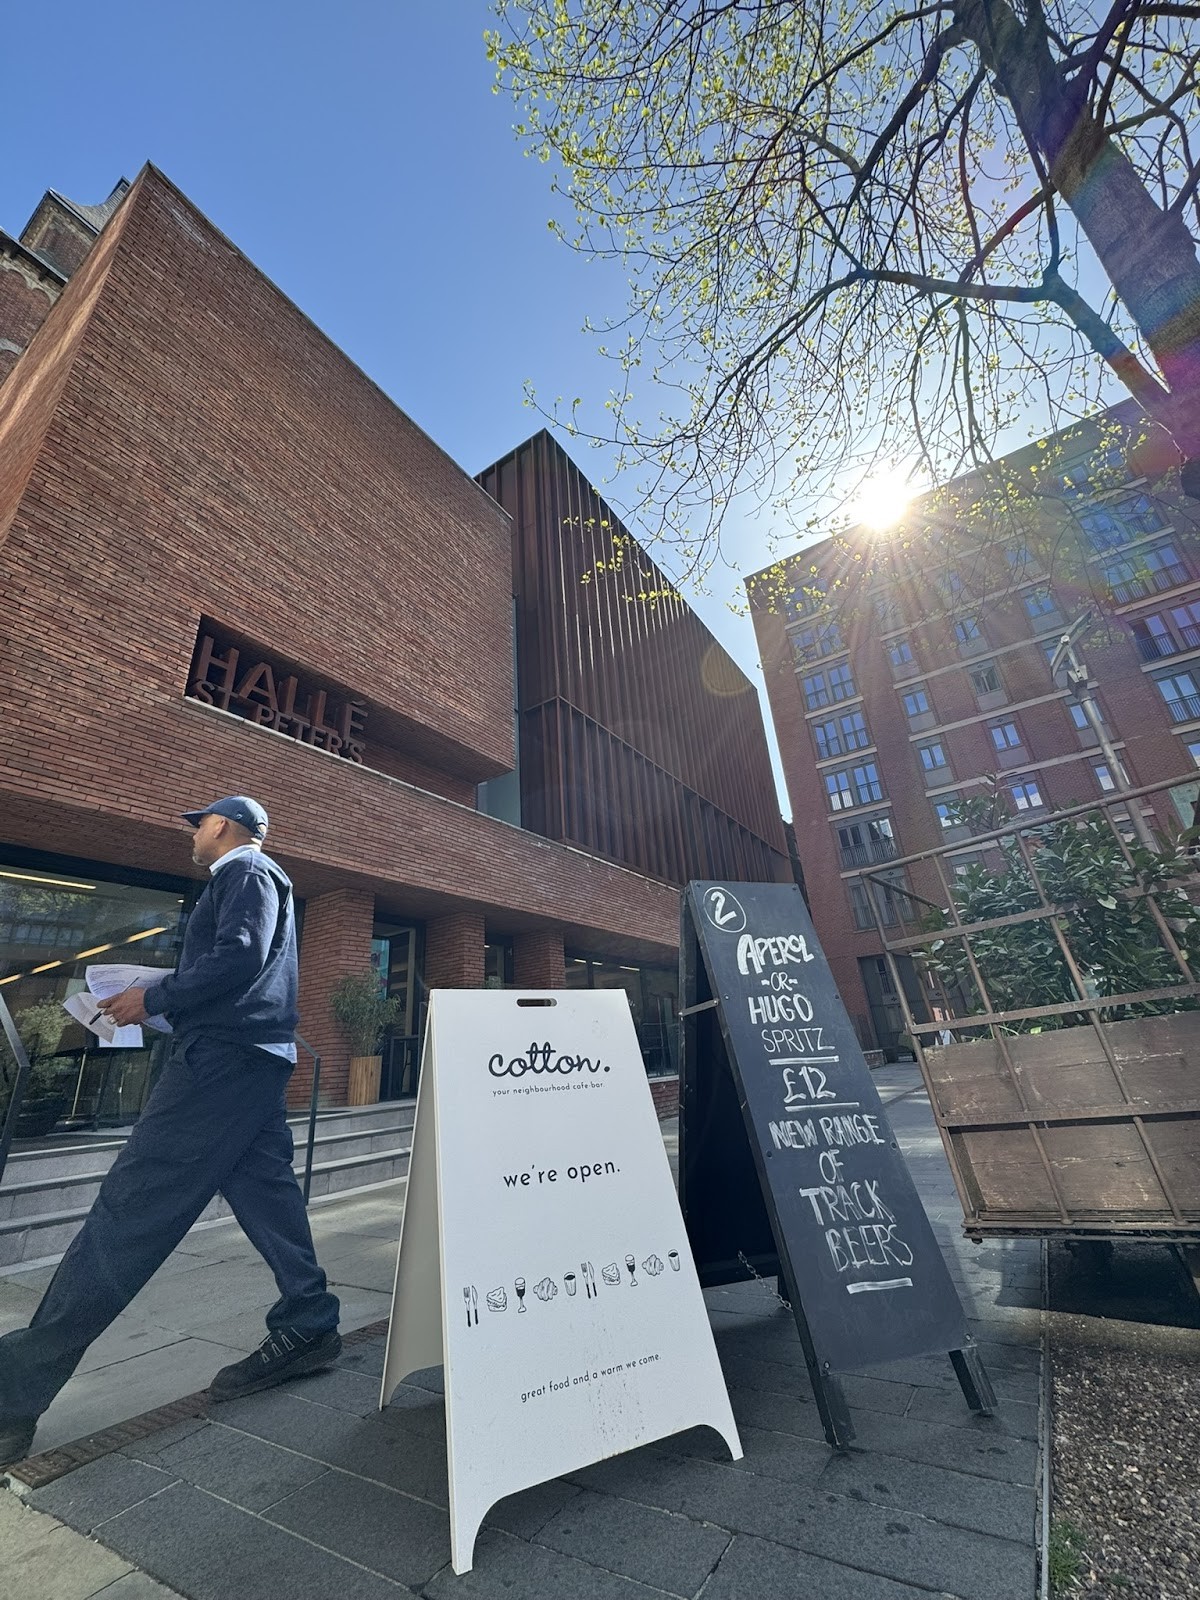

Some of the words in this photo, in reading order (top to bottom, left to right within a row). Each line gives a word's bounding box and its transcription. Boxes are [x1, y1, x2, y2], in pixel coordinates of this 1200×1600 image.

[710, 891, 737, 926] 2
[736, 933, 815, 976] APEROL
[747, 992, 814, 1025] HUGO
[761, 1027, 836, 1053] SPRITZ
[488, 1041, 611, 1078] cotton.
[492, 1088, 510, 1098] your
[513, 1083, 571, 1096] neighbourhood
[783, 1066, 837, 1104] £12
[768, 1117, 819, 1150] NEW
[818, 1113, 886, 1148] RANGE
[503, 1164, 558, 1188] we're
[567, 1161, 620, 1183] open.
[819, 1149, 845, 1185] OF
[799, 1179, 897, 1226] TRACK
[824, 1223, 915, 1273] BEERS
[520, 1384, 546, 1403] great
[550, 1376, 570, 1392] food
[573, 1370, 590, 1386] and
[601, 1363, 623, 1377] warm
